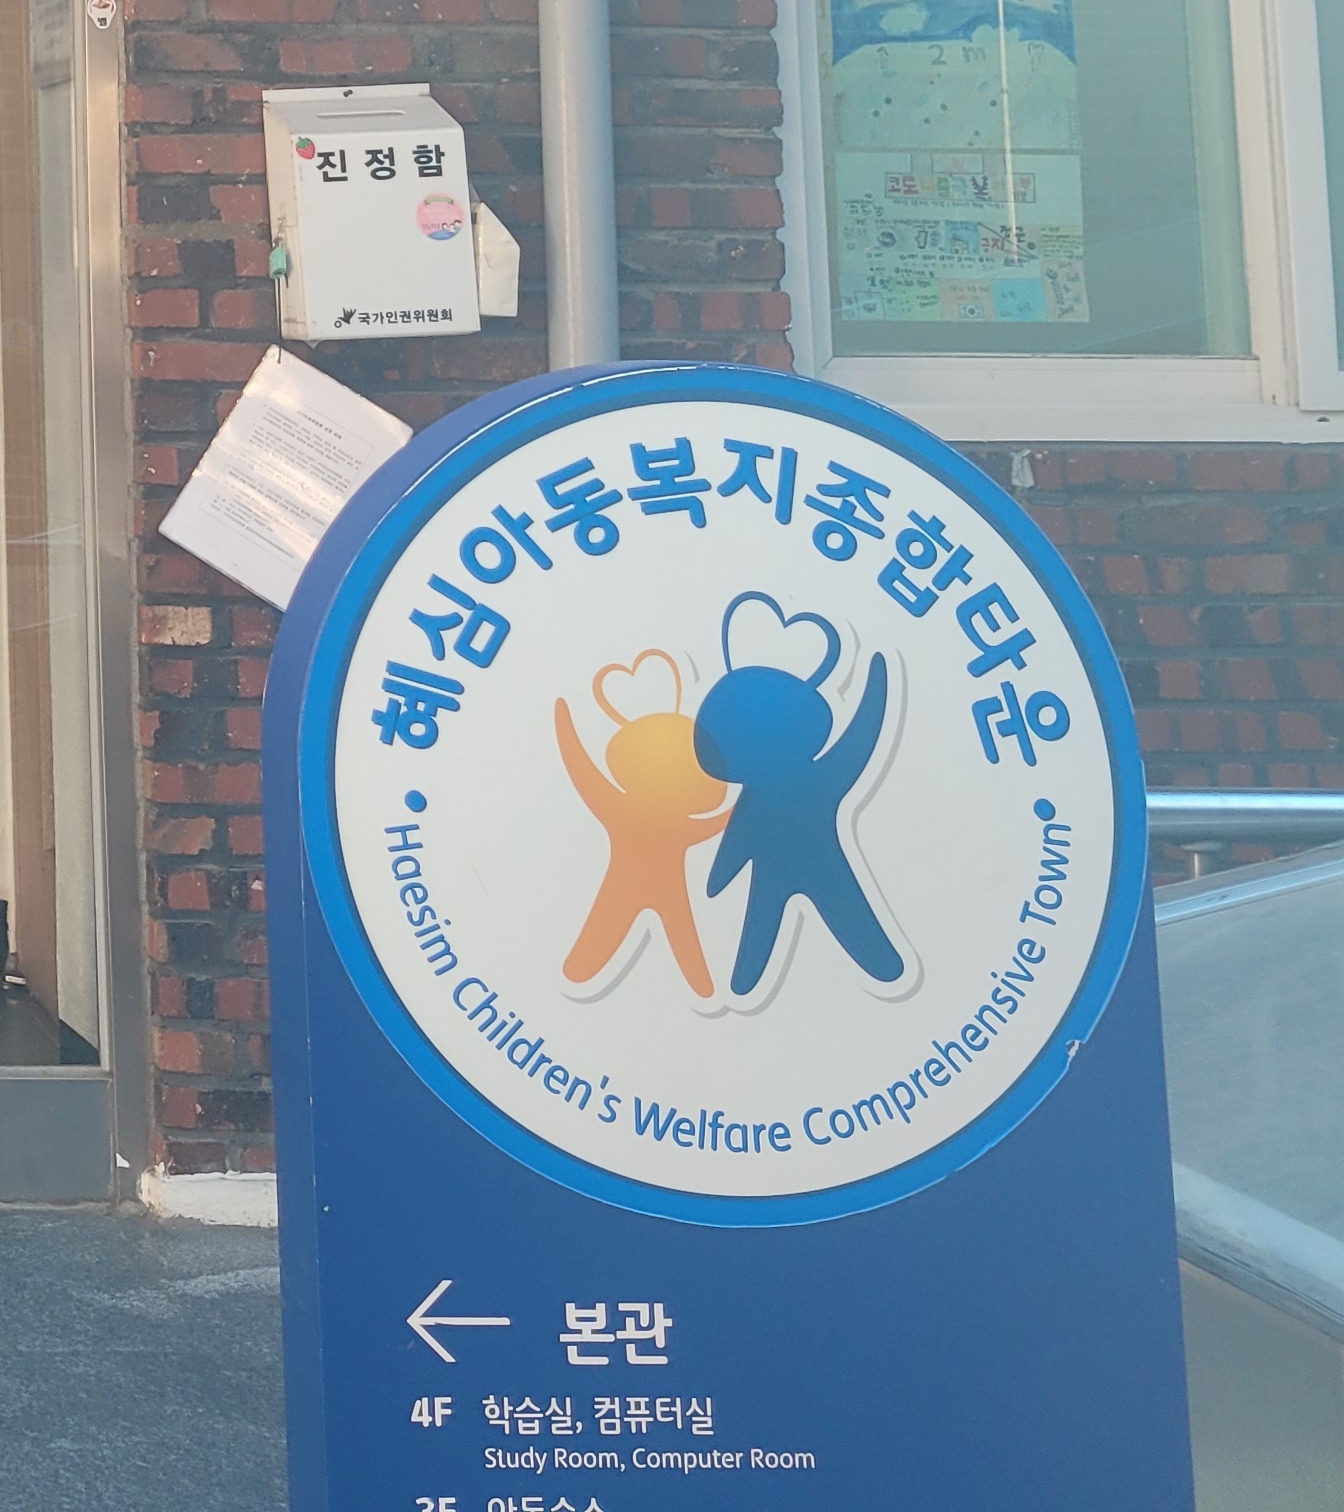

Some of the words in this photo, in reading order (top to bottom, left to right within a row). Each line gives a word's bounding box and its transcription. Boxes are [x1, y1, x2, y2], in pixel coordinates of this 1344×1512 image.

[316, 145, 445, 182] 진정함
[358, 309, 453, 325] 국가인권위원회
[370, 436, 1071, 768] 혜심아동복지종합타운
[384, 823, 459, 976] Haesim
[452, 976, 622, 1125] Children's
[632, 1100, 793, 1155] Welfare
[801, 938, 1049, 1148] Comprehensive
[1018, 823, 1073, 926] Town
[558, 1301, 673, 1366] 본관
[410, 1396, 452, 1427] 4F
[481, 1395, 583, 1434] 학습실,
[593, 1395, 715, 1435] 컴퓨터실
[483, 1446, 547, 1474] Study
[554, 1447, 626, 1472] Room,
[632, 1447, 743, 1474] Computer
[750, 1447, 816, 1469] Room
